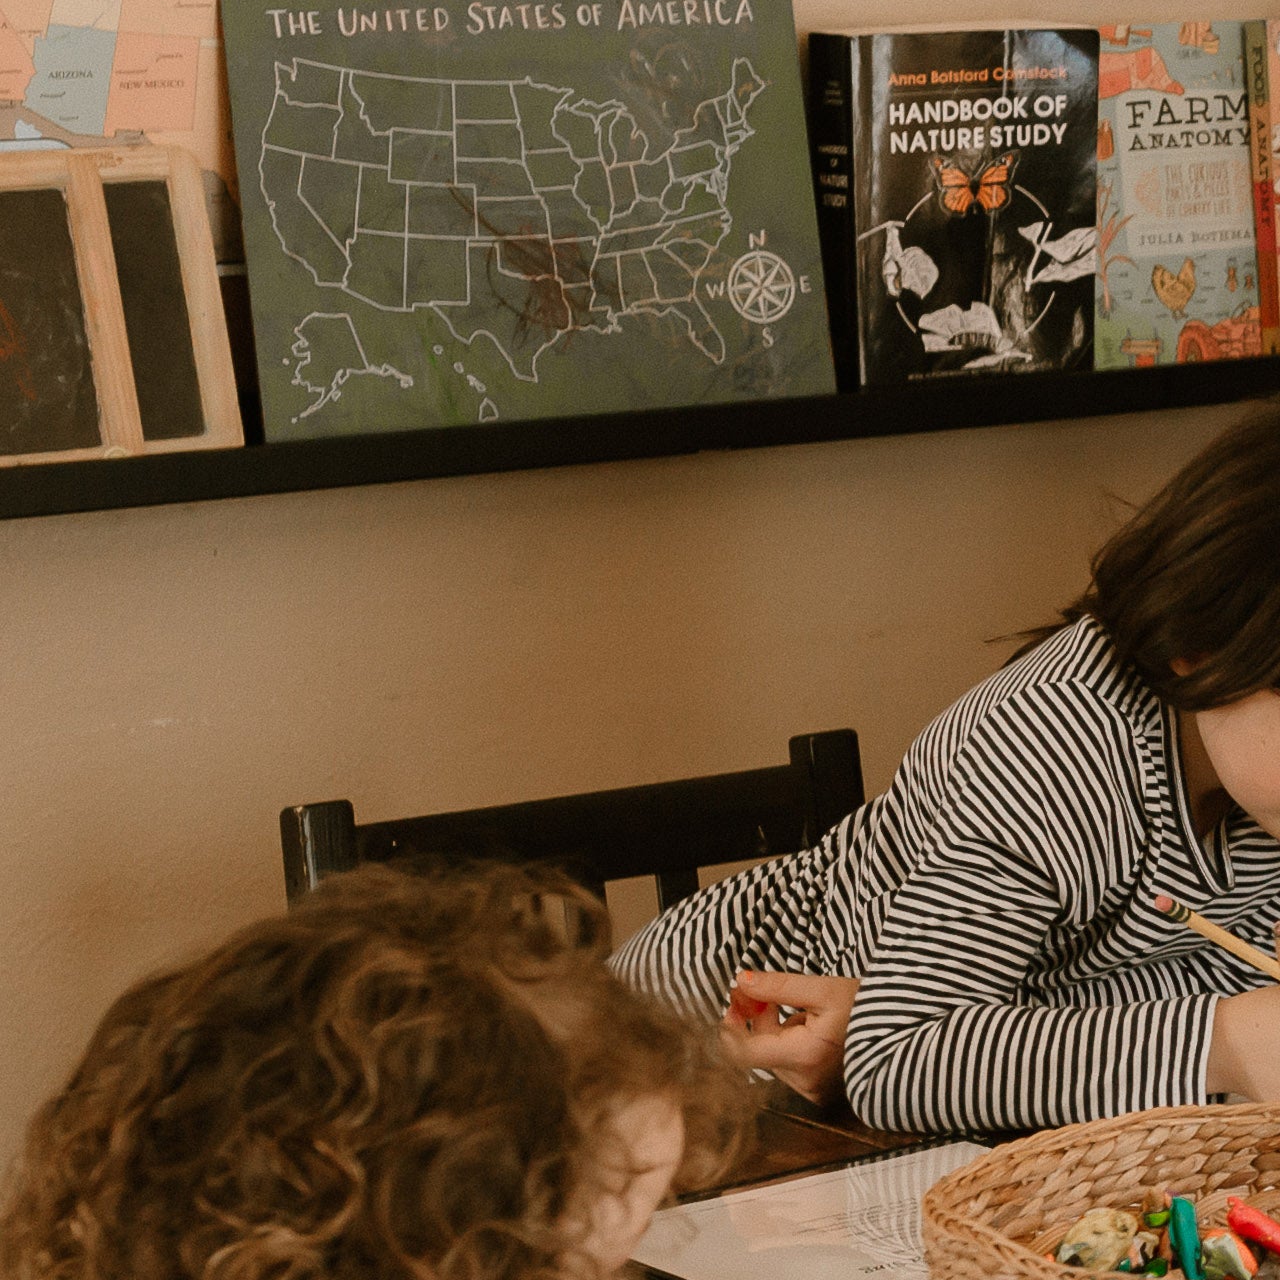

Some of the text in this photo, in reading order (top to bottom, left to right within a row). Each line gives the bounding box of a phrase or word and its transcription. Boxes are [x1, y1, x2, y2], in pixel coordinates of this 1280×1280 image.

[265, 7, 323, 39] THE
[337, 6, 451, 37] UNITED
[466, 0, 566, 36] STATES
[576, 3, 602, 25] OF
[49, 71, 93, 79] ARIZONA
[887, 65, 1068, 88] Anna Botsford Comstock
[1251, 45, 1266, 109] FOOD
[888, 94, 1068, 126] HANDBOOK OF
[1125, 93, 1249, 129] FARM
[889, 122, 1069, 155] NATURE STUDY
[1128, 128, 1250, 151] ANATOMY
[748, 229, 765, 249] N
[705, 281, 725, 299] W
[800, 275, 812, 293] E
[762, 327, 774, 349] S
